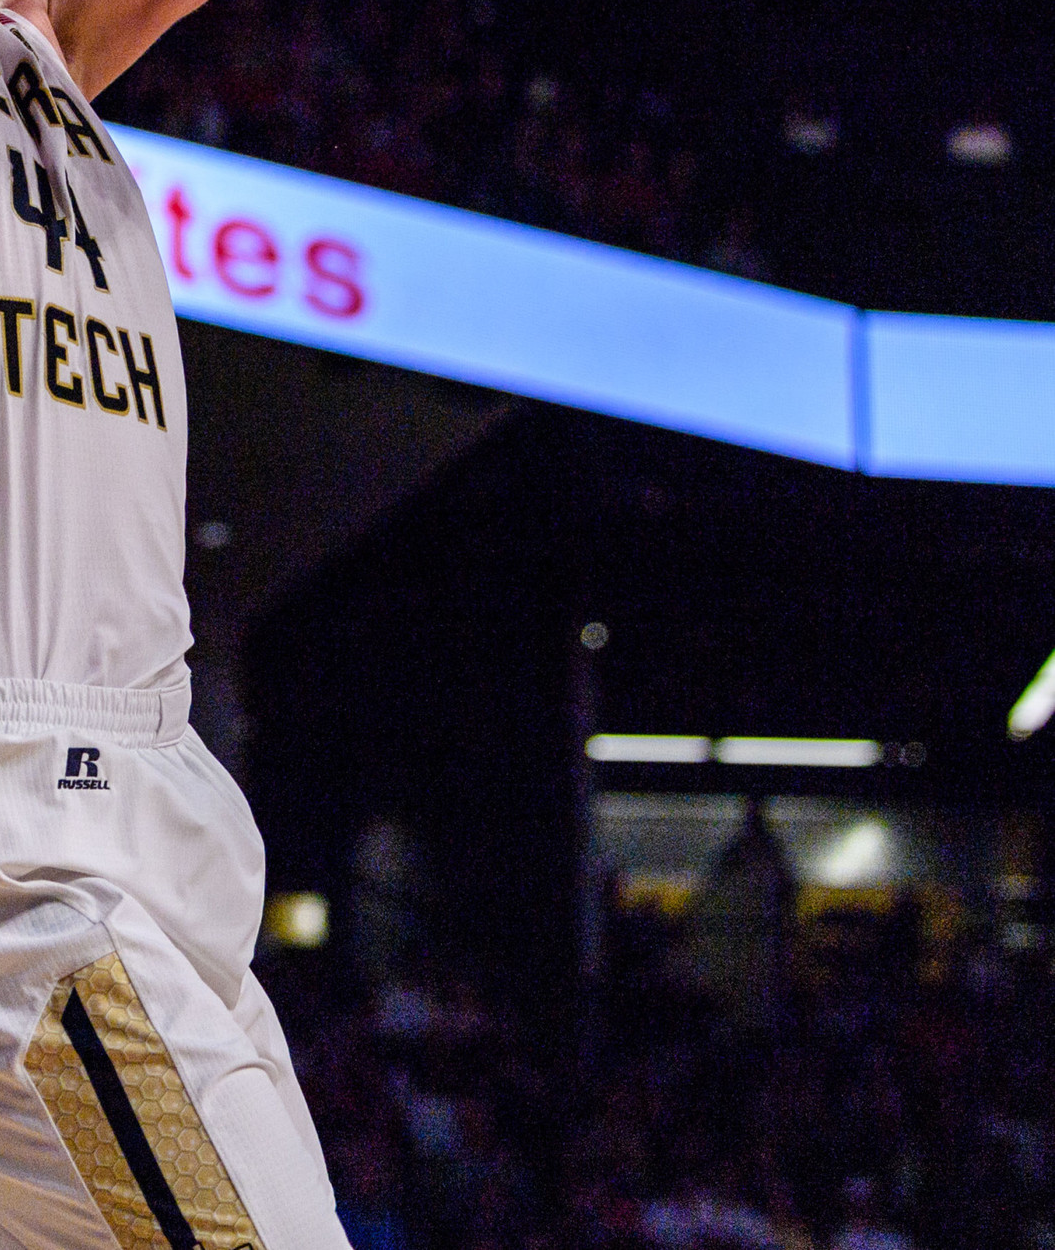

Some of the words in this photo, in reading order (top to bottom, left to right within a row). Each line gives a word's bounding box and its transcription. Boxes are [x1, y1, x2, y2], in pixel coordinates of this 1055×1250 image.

[6, 144, 111, 294] 44
[164, 186, 364, 319] tes
[57, 779, 110, 790] RUSSELL
[65, 747, 100, 778] R
